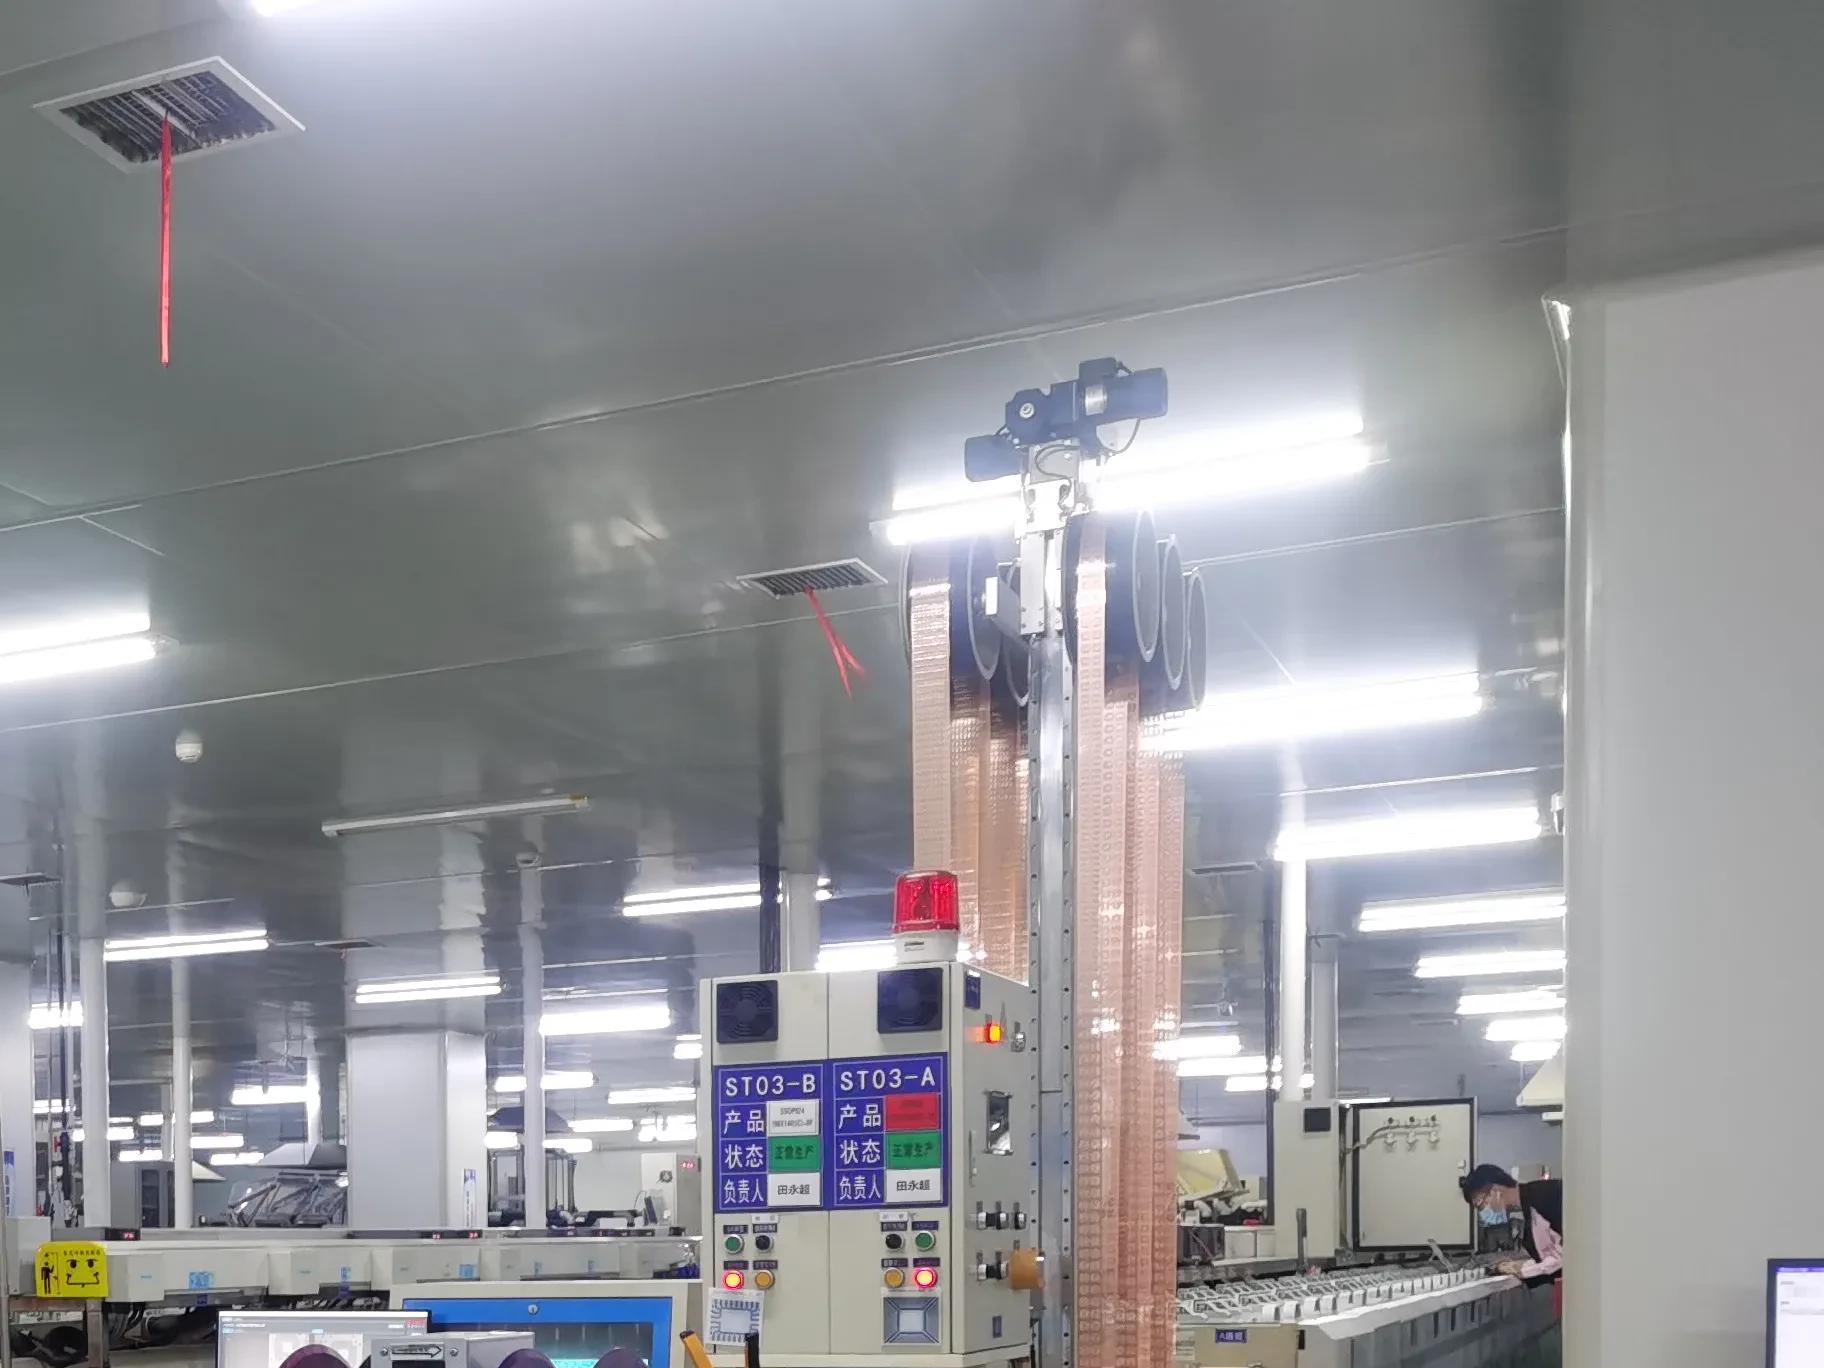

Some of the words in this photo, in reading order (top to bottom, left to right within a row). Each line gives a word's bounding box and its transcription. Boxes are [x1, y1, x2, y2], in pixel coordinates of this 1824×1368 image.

[725, 1073, 816, 1097] ST03-B
[840, 1066, 936, 1091] ST03-A
[723, 1109, 765, 1135] 产品
[838, 1103, 881, 1129] 产品
[724, 1144, 764, 1169] 状态
[839, 1138, 881, 1165] 状态
[723, 1178, 764, 1205] 负责人
[839, 1173, 881, 1201] 负责人
